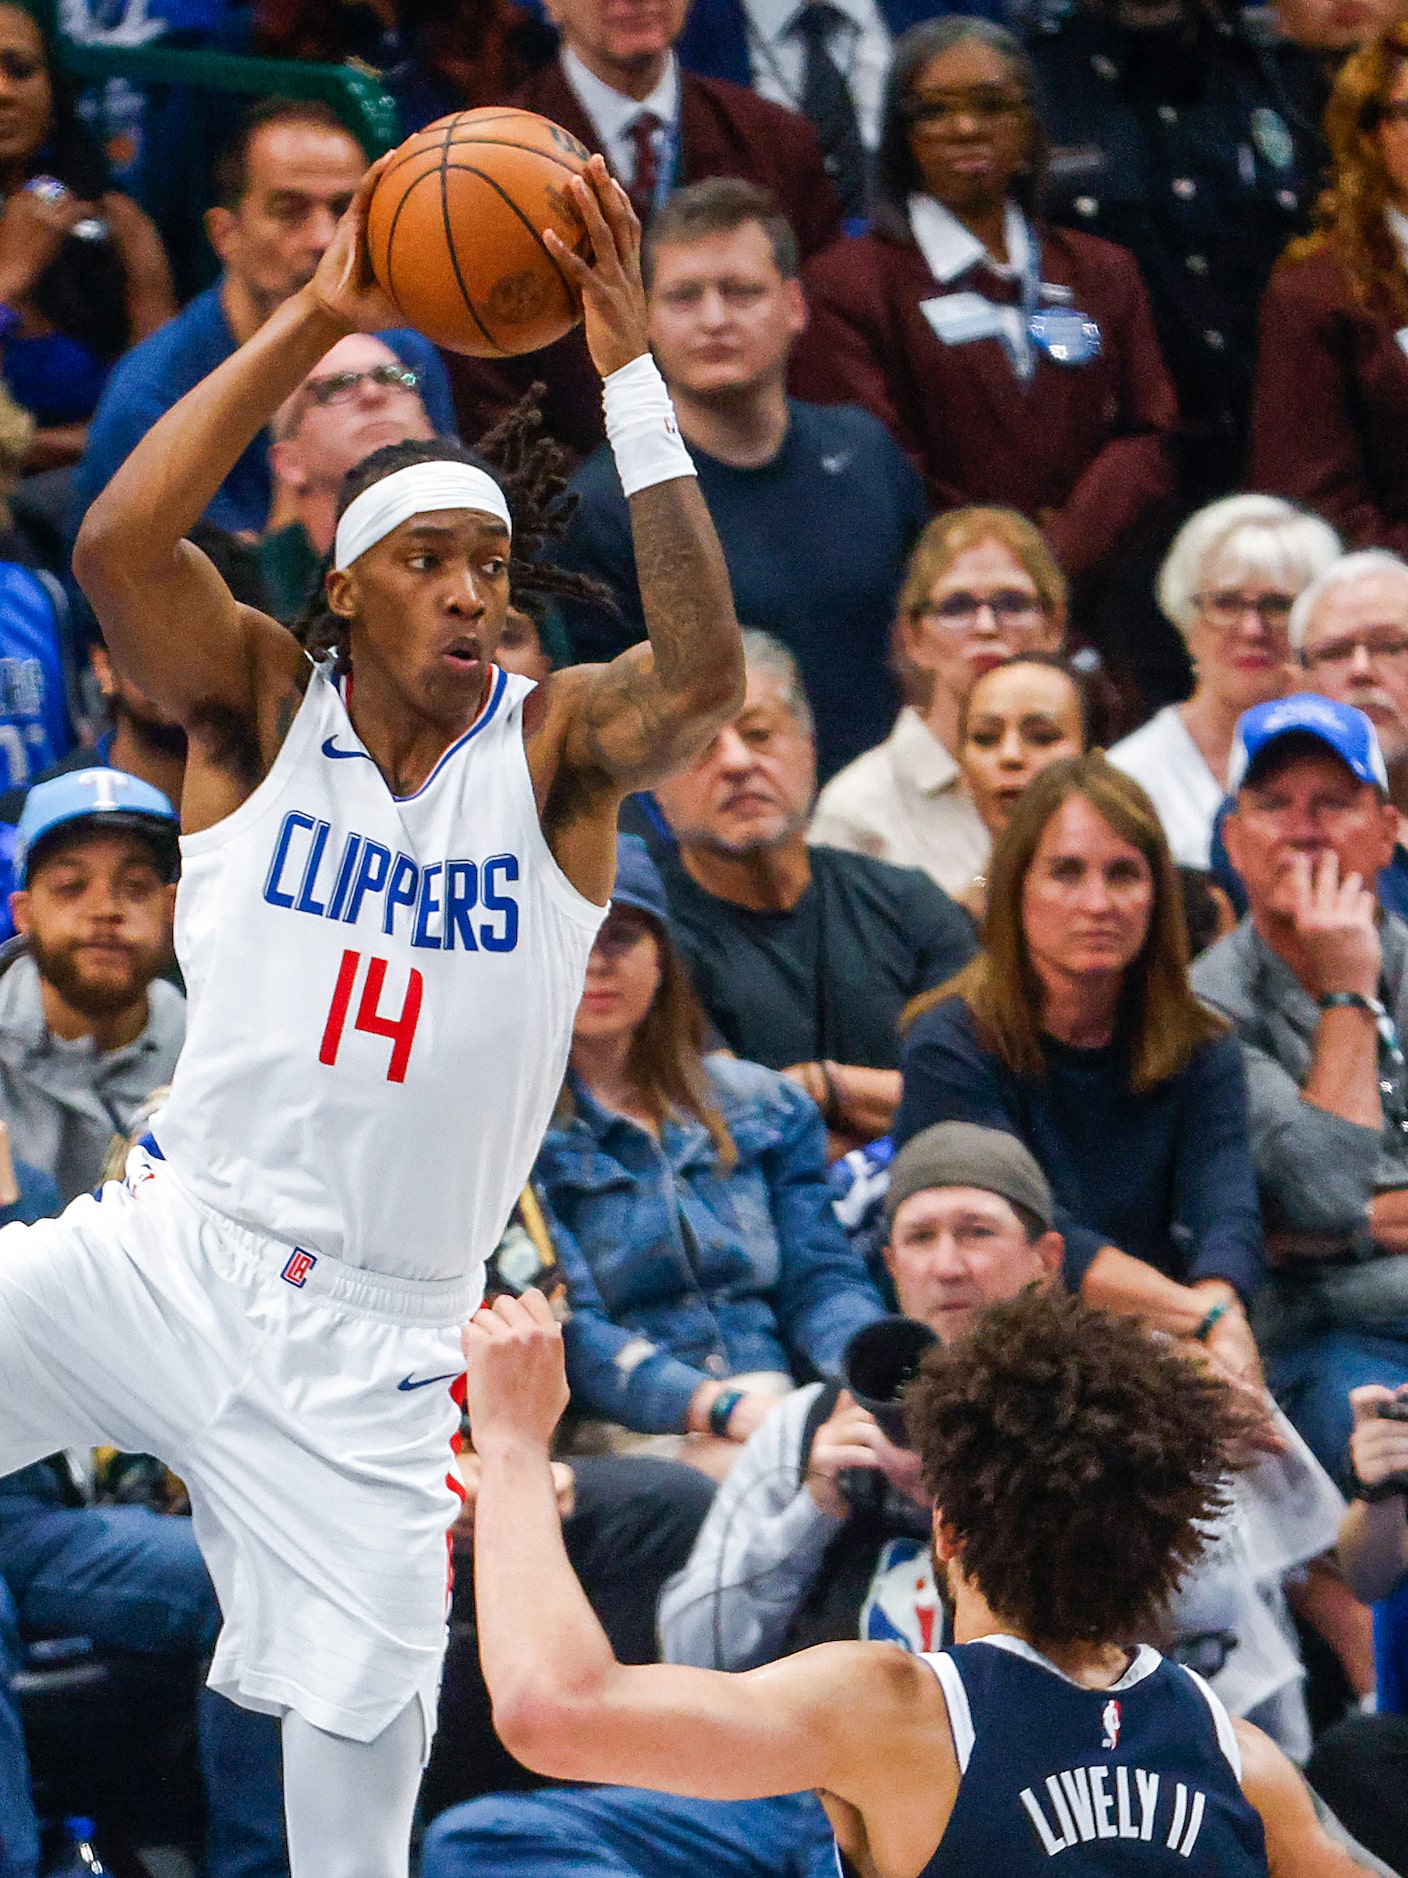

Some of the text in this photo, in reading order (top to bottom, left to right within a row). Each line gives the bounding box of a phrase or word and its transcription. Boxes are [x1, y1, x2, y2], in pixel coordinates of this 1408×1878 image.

[78, 770, 129, 811] T
[263, 809, 520, 954] CLIPPERS
[318, 949, 424, 1084] 14
[1019, 1765, 1206, 1858] LIVELY II
